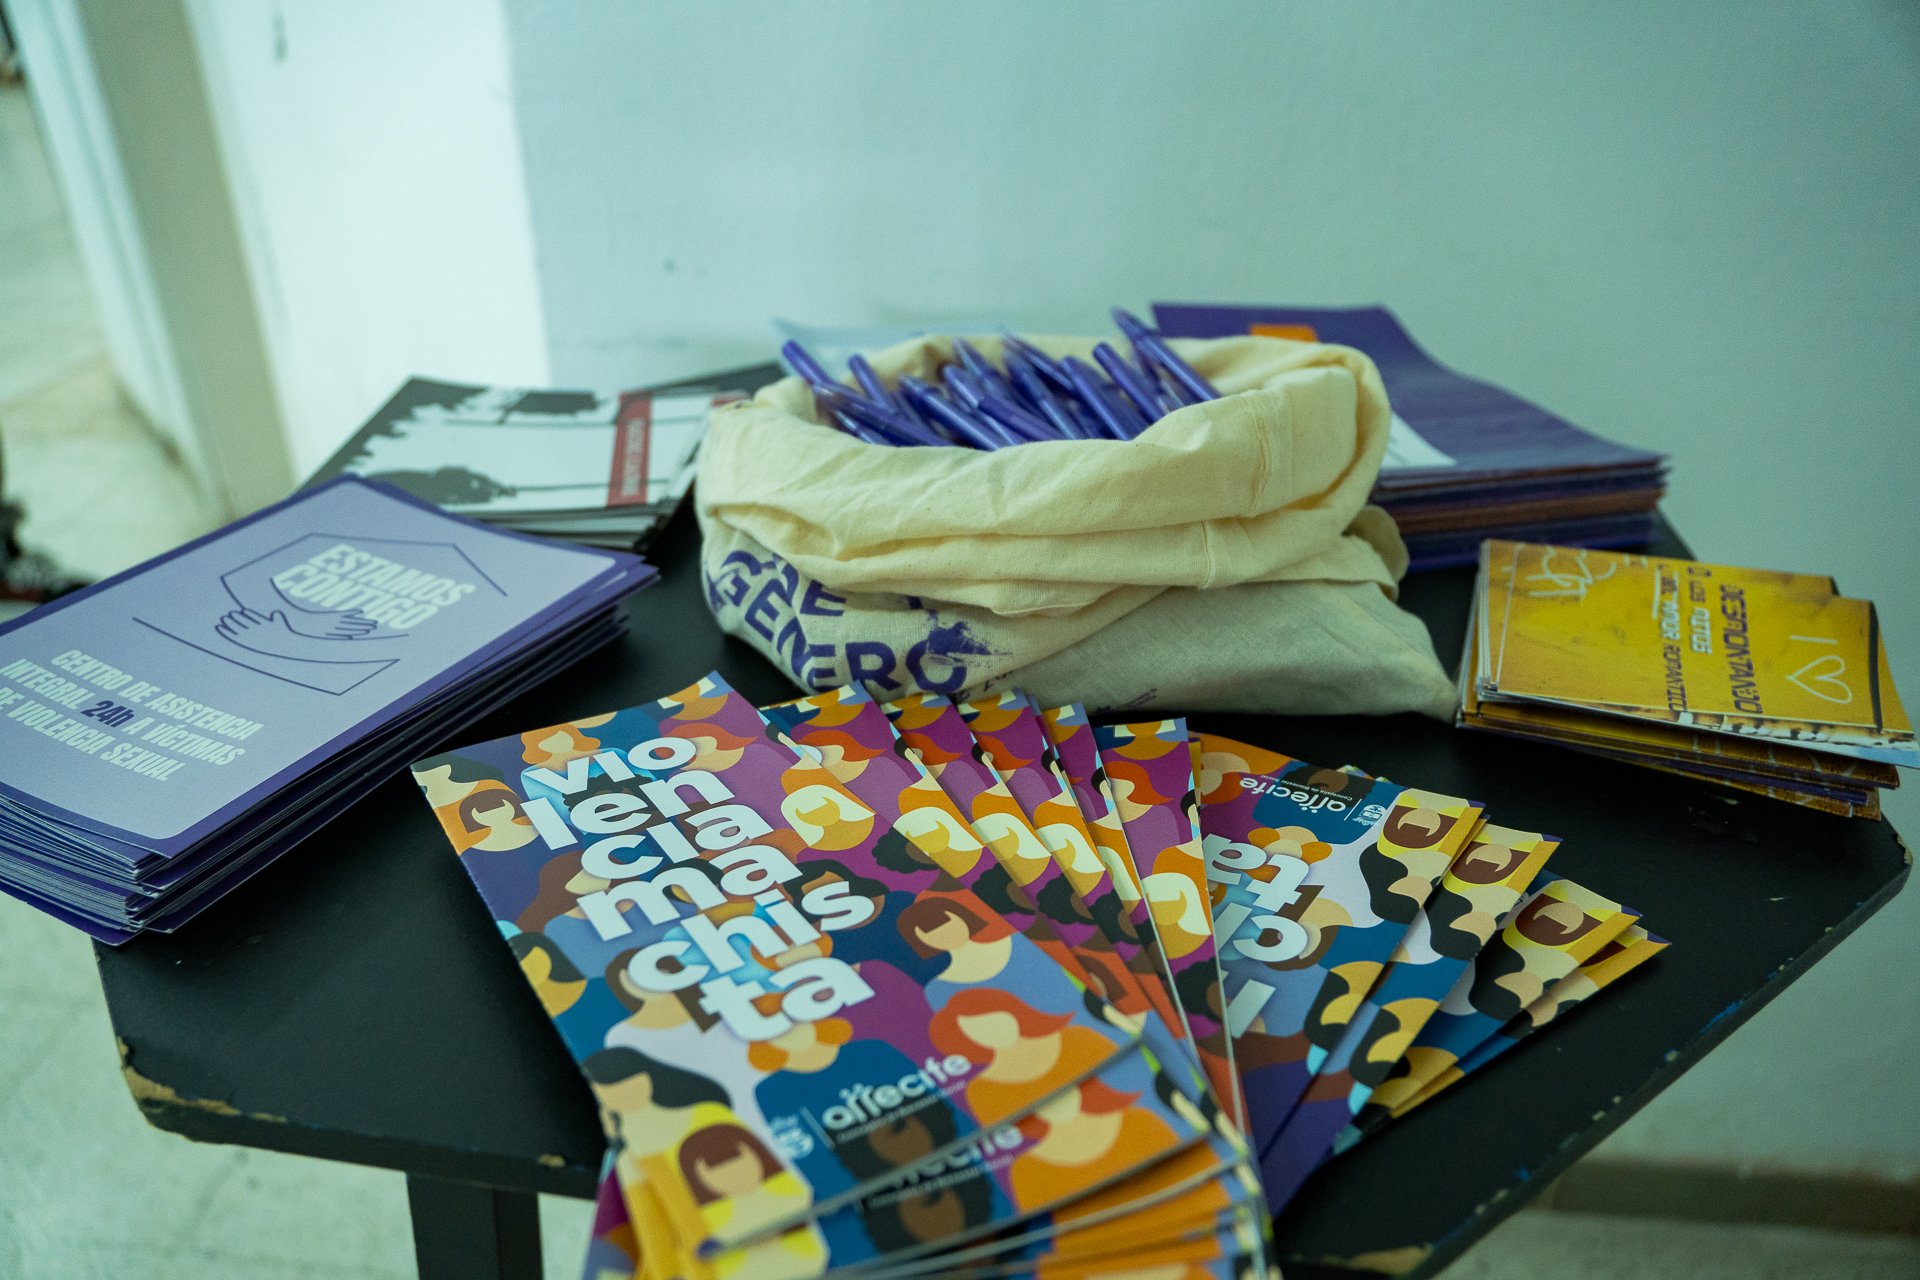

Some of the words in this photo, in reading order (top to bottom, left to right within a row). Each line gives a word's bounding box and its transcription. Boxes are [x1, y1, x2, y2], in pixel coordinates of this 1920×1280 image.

[273, 564, 438, 629] CONTIGO
[309, 543, 476, 606] ESTAMOS
[0, 658, 96, 710] INTEGRAL
[80, 700, 135, 728] 24h
[121, 717, 155, 735] A
[141, 722, 246, 765] VÍCTIMAS
[51, 650, 133, 690] CENTRO
[118, 681, 161, 703] DE
[144, 692, 265, 740] ASISTENCIA
[8, 700, 116, 755] VIOLENCIA
[100, 743, 186, 781] SEXUAL
[523, 737, 697, 795] vio
[520, 770, 735, 850] len
[581, 804, 774, 880] cia
[577, 845, 803, 941] ma
[627, 881, 875, 992] chis
[699, 957, 875, 1041] ta
